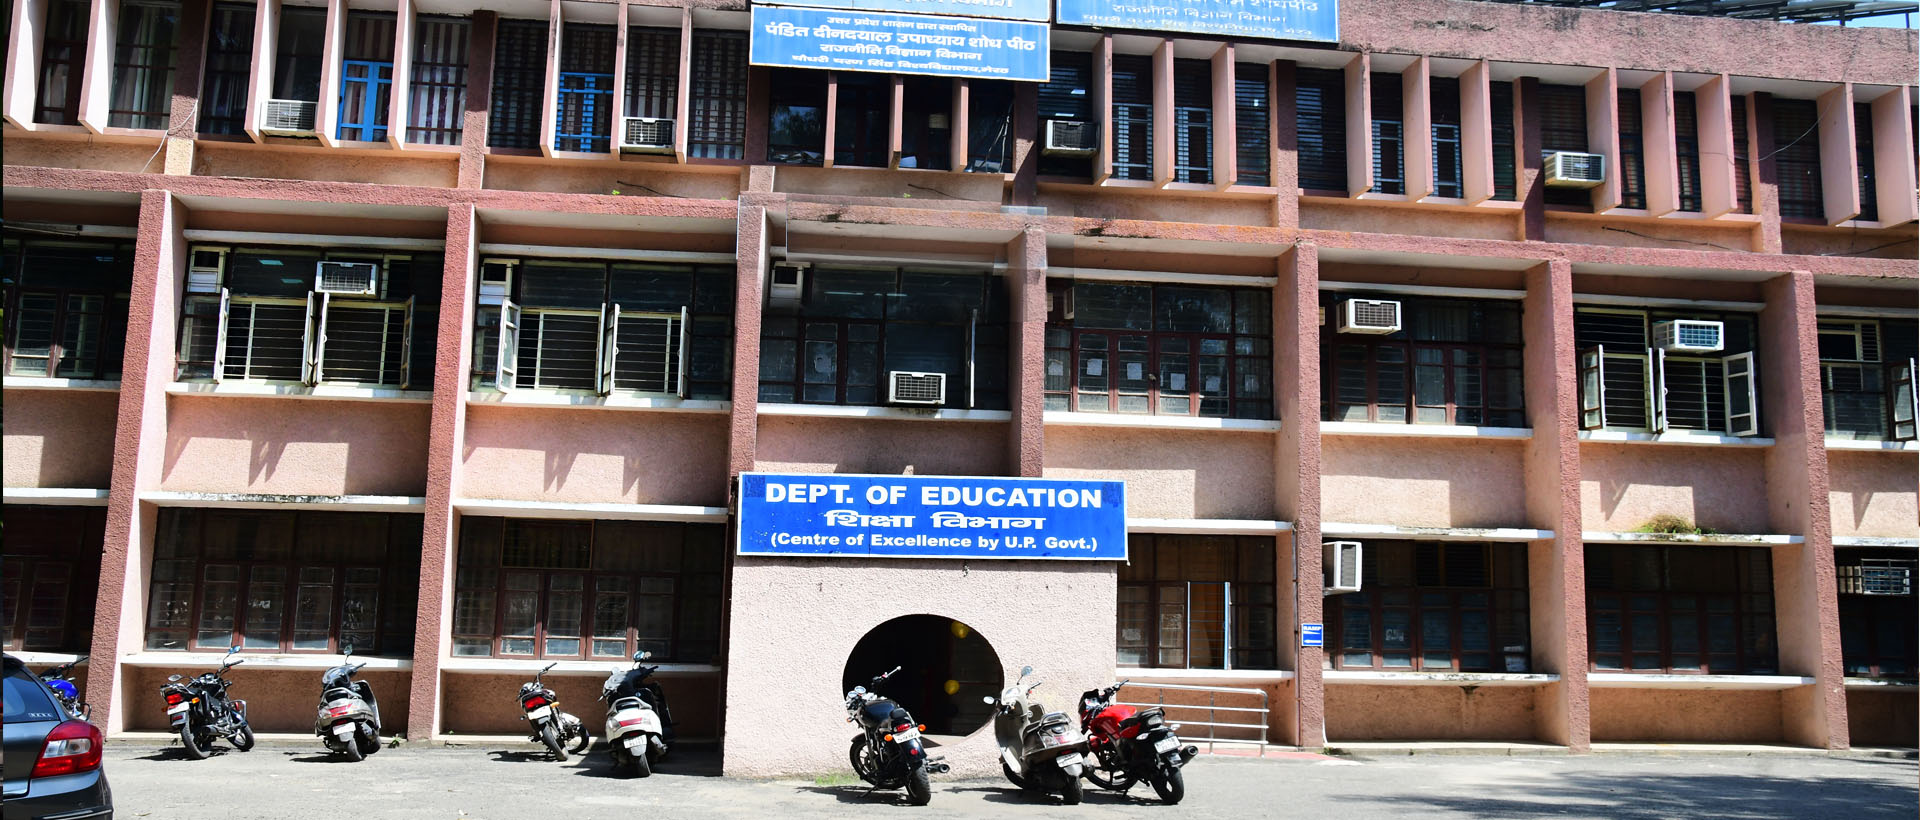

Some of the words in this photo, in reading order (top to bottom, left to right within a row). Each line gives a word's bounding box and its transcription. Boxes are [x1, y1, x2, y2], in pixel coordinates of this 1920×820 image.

[765, 22, 809, 37] पंडित
[813, 25, 893, 42] दीनदयाल
[897, 32, 966, 47] उपाध्याय
[968, 35, 1002, 49] शोध
[1006, 36, 1036, 51] पीठ
[820, 43, 882, 55] राजनीति
[885, 45, 931, 57] विज्ञान
[935, 47, 982, 61] विभाग
[766, 483, 854, 504] DEPT.
[865, 485, 908, 505] OF
[921, 486, 1101, 508] EDUCATION
[824, 509, 916, 528] शिक्षा
[930, 511, 1047, 530] विभाग
[771, 532, 840, 547] (Centre
[845, 533, 865, 546] of
[871, 534, 972, 548] Excellence
[978, 536, 999, 550] by
[1005, 536, 1037, 549] U.P.
[1044, 537, 1098, 552] Govt.)
